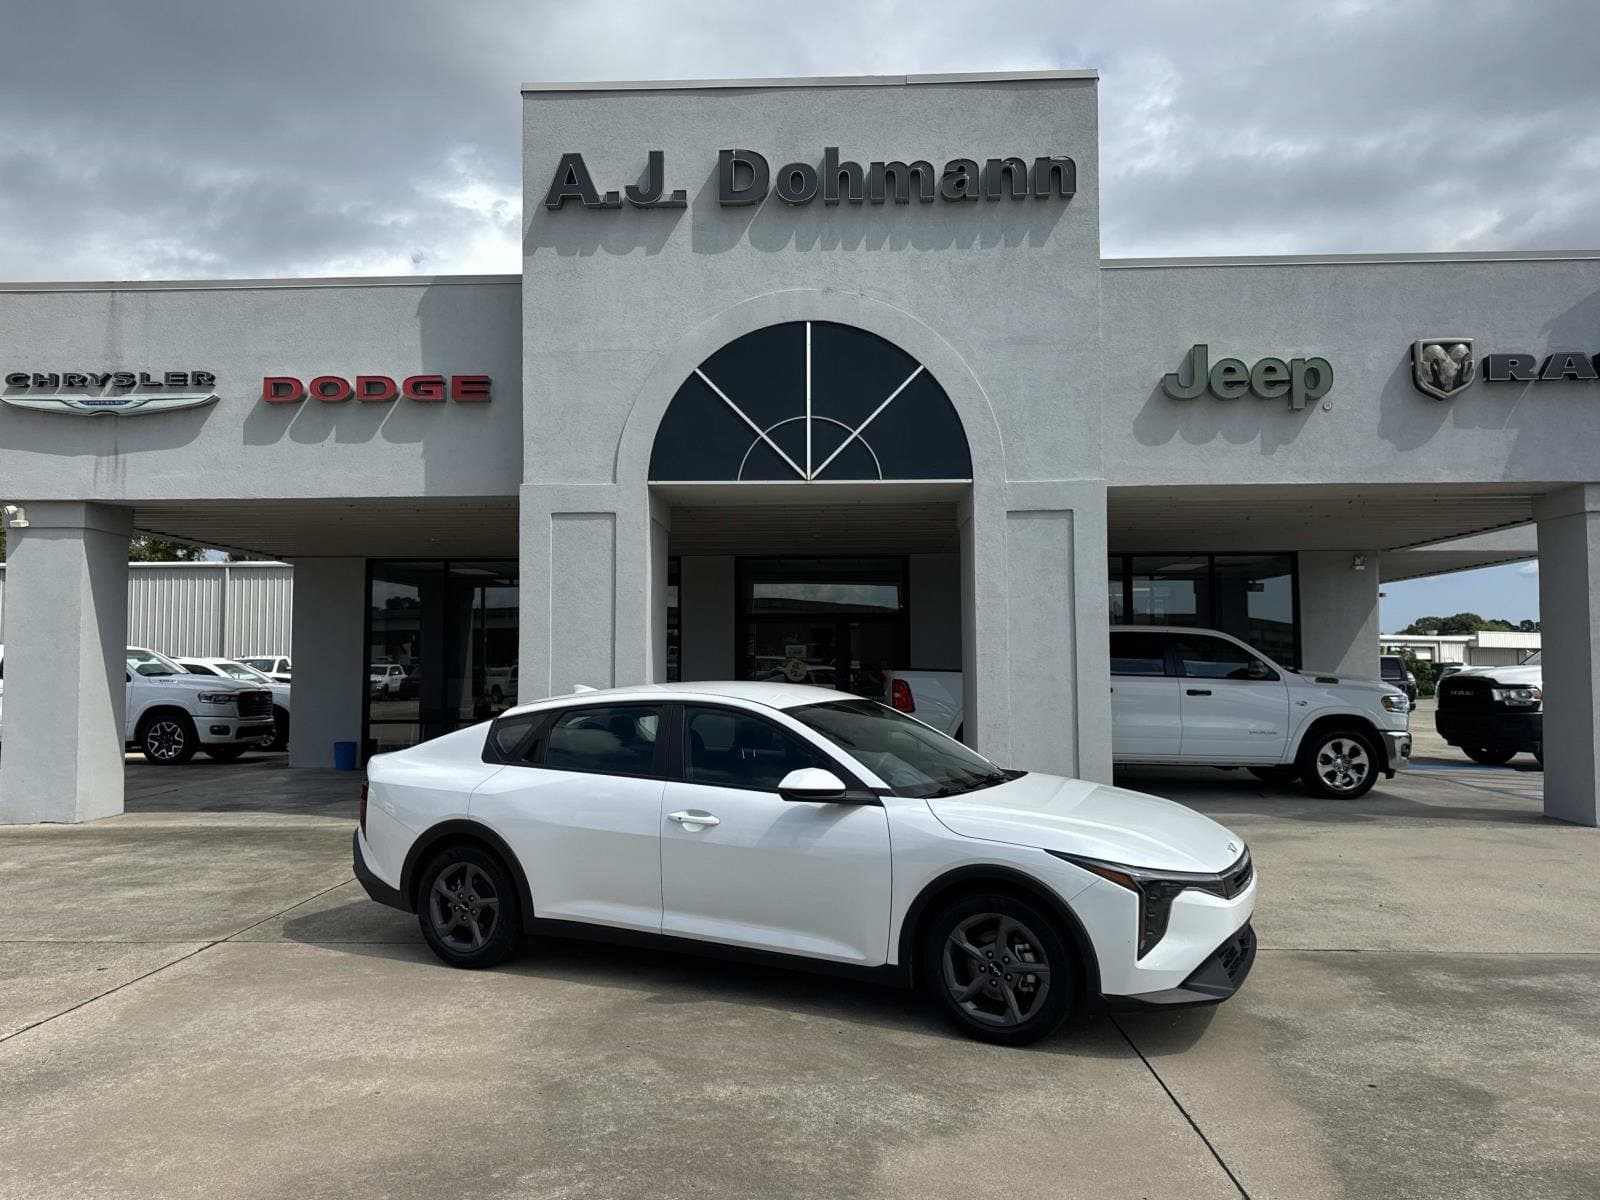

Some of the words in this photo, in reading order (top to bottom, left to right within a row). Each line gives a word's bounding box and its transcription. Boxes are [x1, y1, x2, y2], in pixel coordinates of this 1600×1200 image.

[544, 150, 687, 208] A.J.
[718, 146, 1077, 206] Dohmann
[5, 371, 216, 388] CHRYSLER
[1162, 343, 1334, 411] Jeep
[1483, 351, 1600, 382] RA
[263, 374, 492, 402] DODGE
